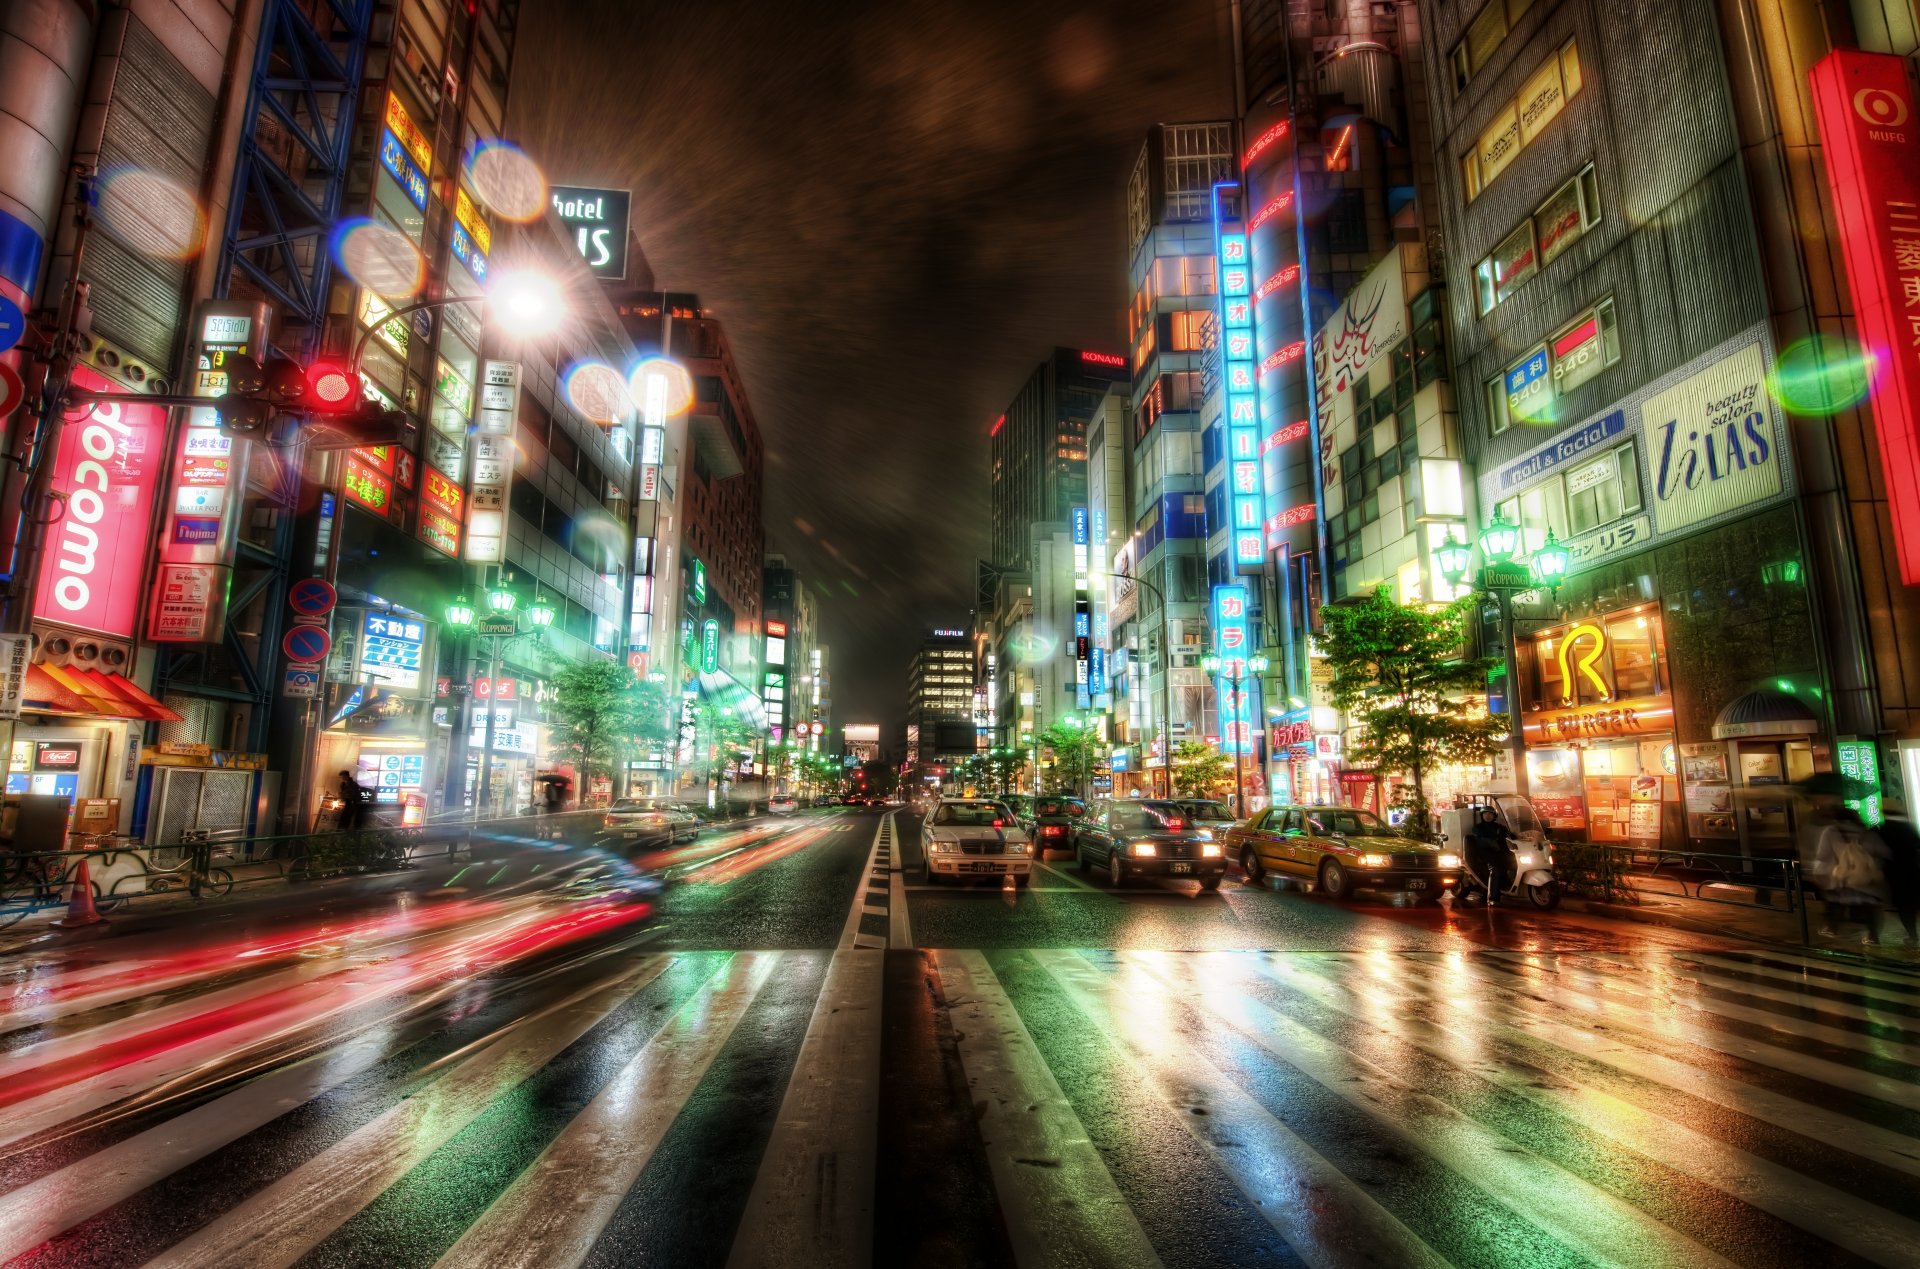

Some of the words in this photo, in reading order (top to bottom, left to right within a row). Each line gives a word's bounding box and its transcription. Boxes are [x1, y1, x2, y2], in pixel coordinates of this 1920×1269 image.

[1869, 130, 1906, 143] MUFG
[384, 141, 425, 204] 心療内科
[553, 194, 604, 220] hotel
[1081, 351, 1125, 366] KONAMI
[1511, 356, 1543, 389] 歯科
[1554, 341, 1599, 380] 8461
[1224, 241, 1261, 557] カラオケ&パーティー館
[1510, 375, 1549, 408] 3401
[1706, 382, 1758, 416] beauty
[1313, 328, 1338, 489] オリエンタル
[1711, 401, 1754, 429] salon
[114, 437, 131, 471] NTT
[1511, 455, 1542, 486] nail
[1544, 454, 1555, 465] &
[1557, 419, 1608, 462] facial
[428, 473, 460, 507] エステ
[478, 472, 501, 480] エステ
[478, 487, 499, 495] 不動産
[643, 466, 655, 497] Kelly
[54, 390, 131, 611] docomo
[178, 524, 216, 541] Nojima
[1600, 522, 1636, 549] リラ
[1488, 568, 1530, 587] ROPPONGI
[369, 617, 421, 640] 不動産
[479, 620, 514, 633] ROPPONGI
[934, 629, 963, 637] FUJIFILM
[378, 637, 409, 648] マンション
[706, 629, 716, 670] モスバーガー
[1222, 596, 1251, 743] カラオケ館
[1559, 624, 1609, 706] R
[476, 713, 507, 722] DRGS
[1556, 707, 1639, 732] BURGER
[1273, 719, 1312, 748] カラオケ館
[1840, 745, 1861, 781] 歯科
